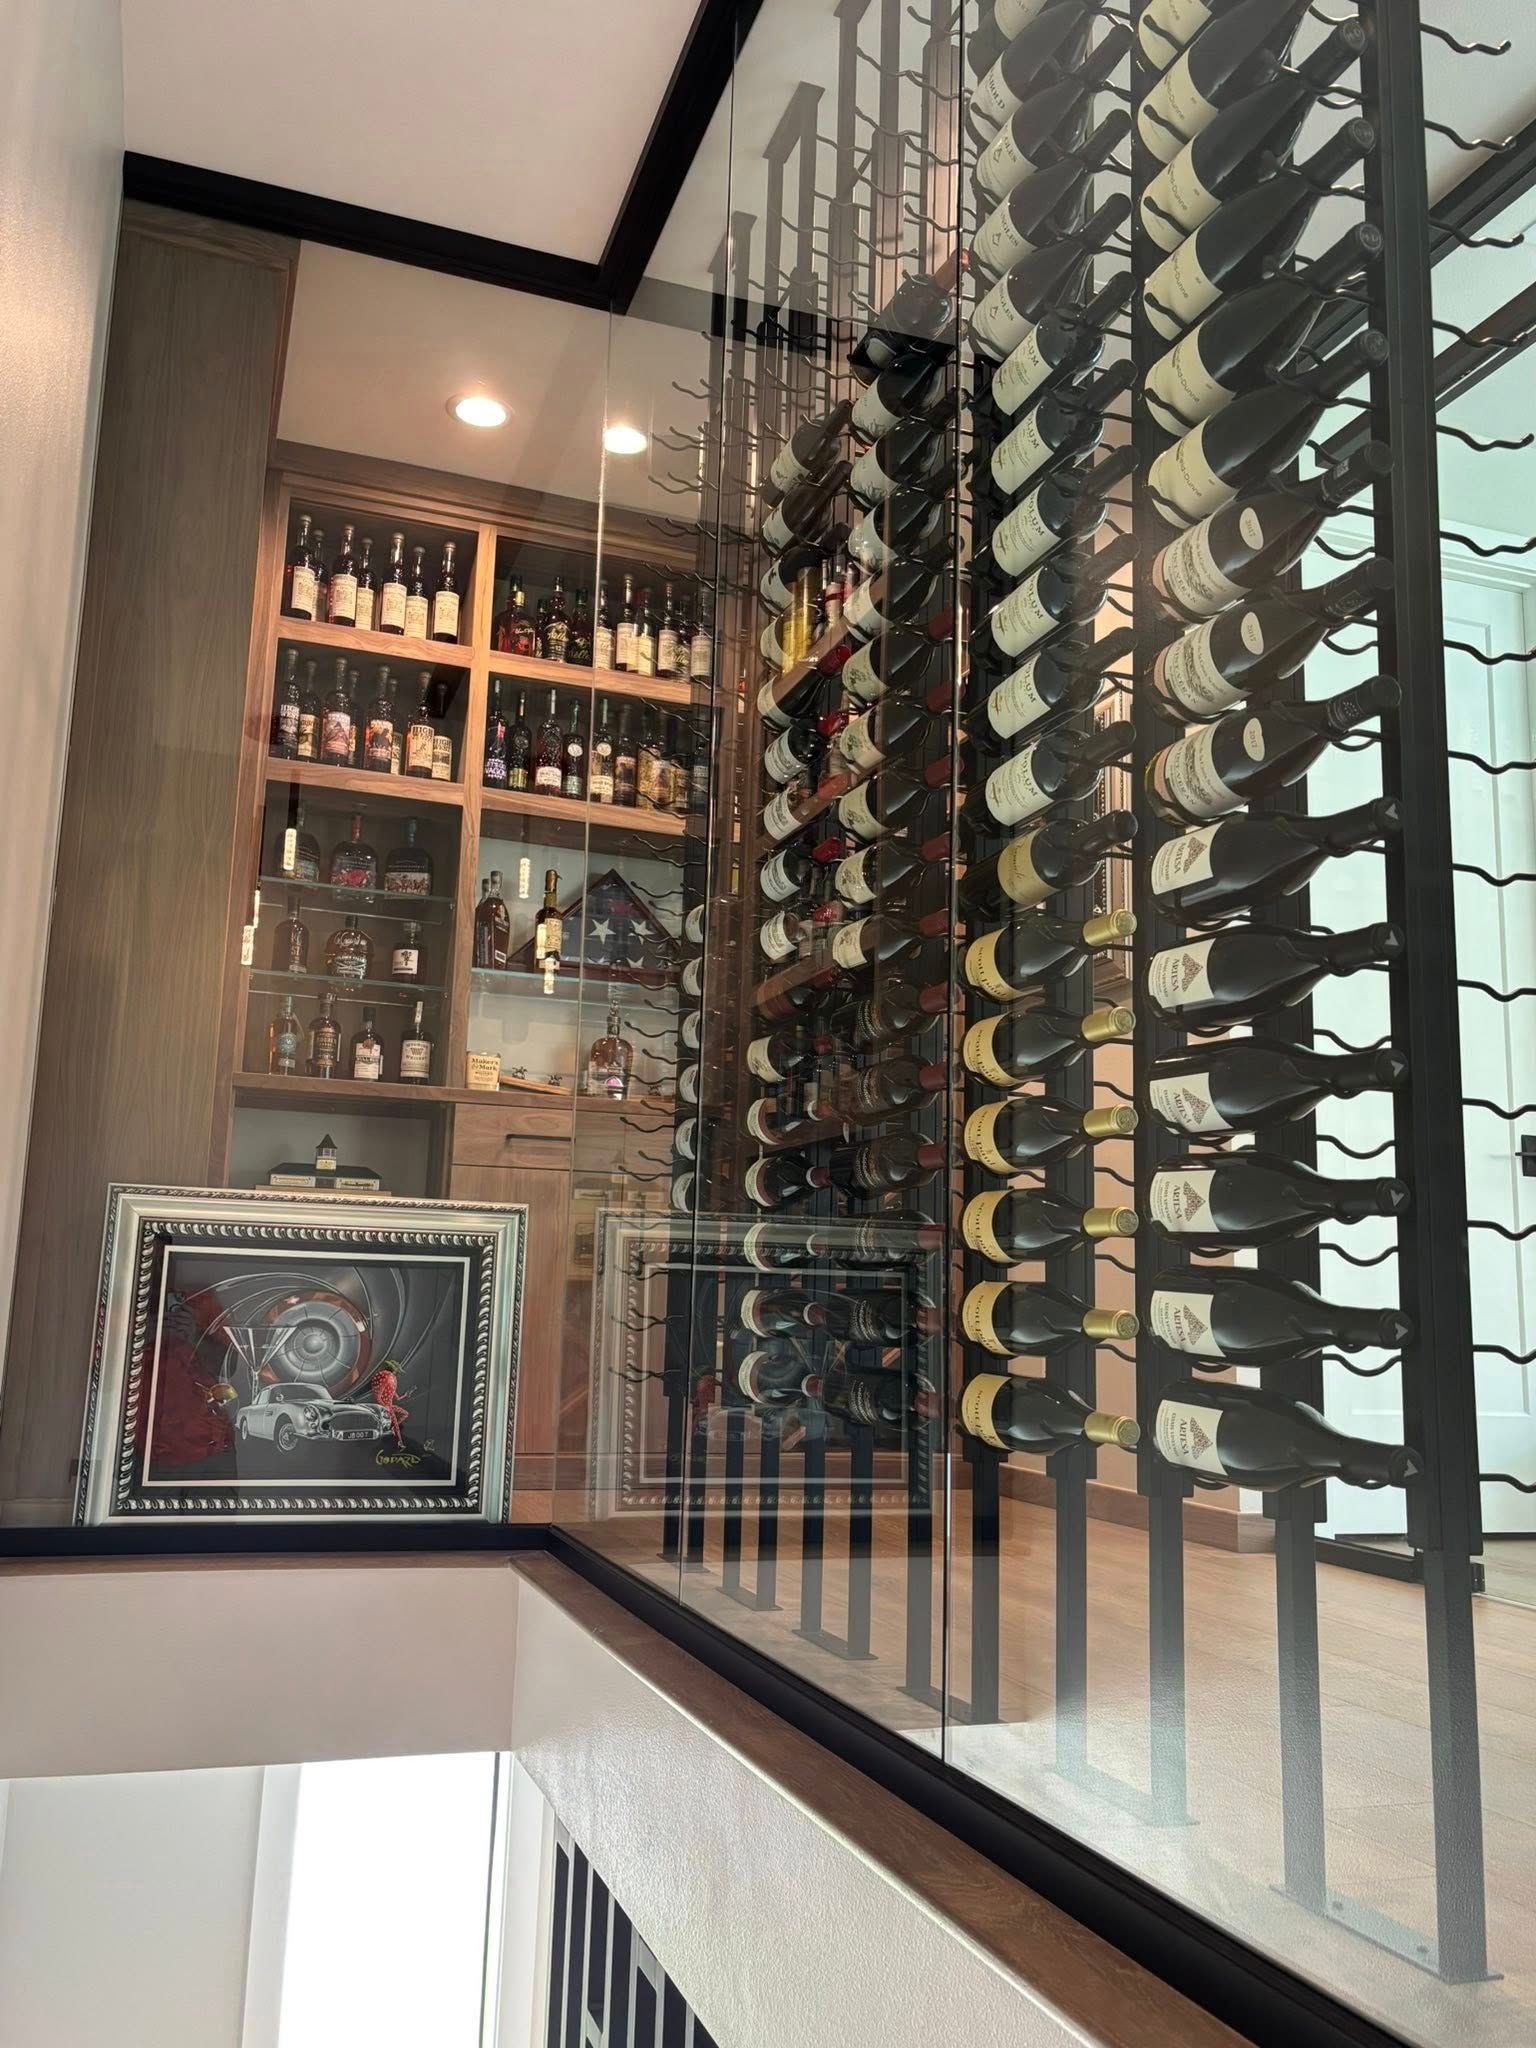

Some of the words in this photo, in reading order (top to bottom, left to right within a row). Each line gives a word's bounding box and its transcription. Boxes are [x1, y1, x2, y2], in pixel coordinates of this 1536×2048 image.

[1171, 958, 1180, 991] ARTESA
[1172, 1184, 1182, 1219] ARTESA
[1173, 1307, 1187, 1342] ARTESA
[1179, 1419, 1190, 1454] ARTESA
